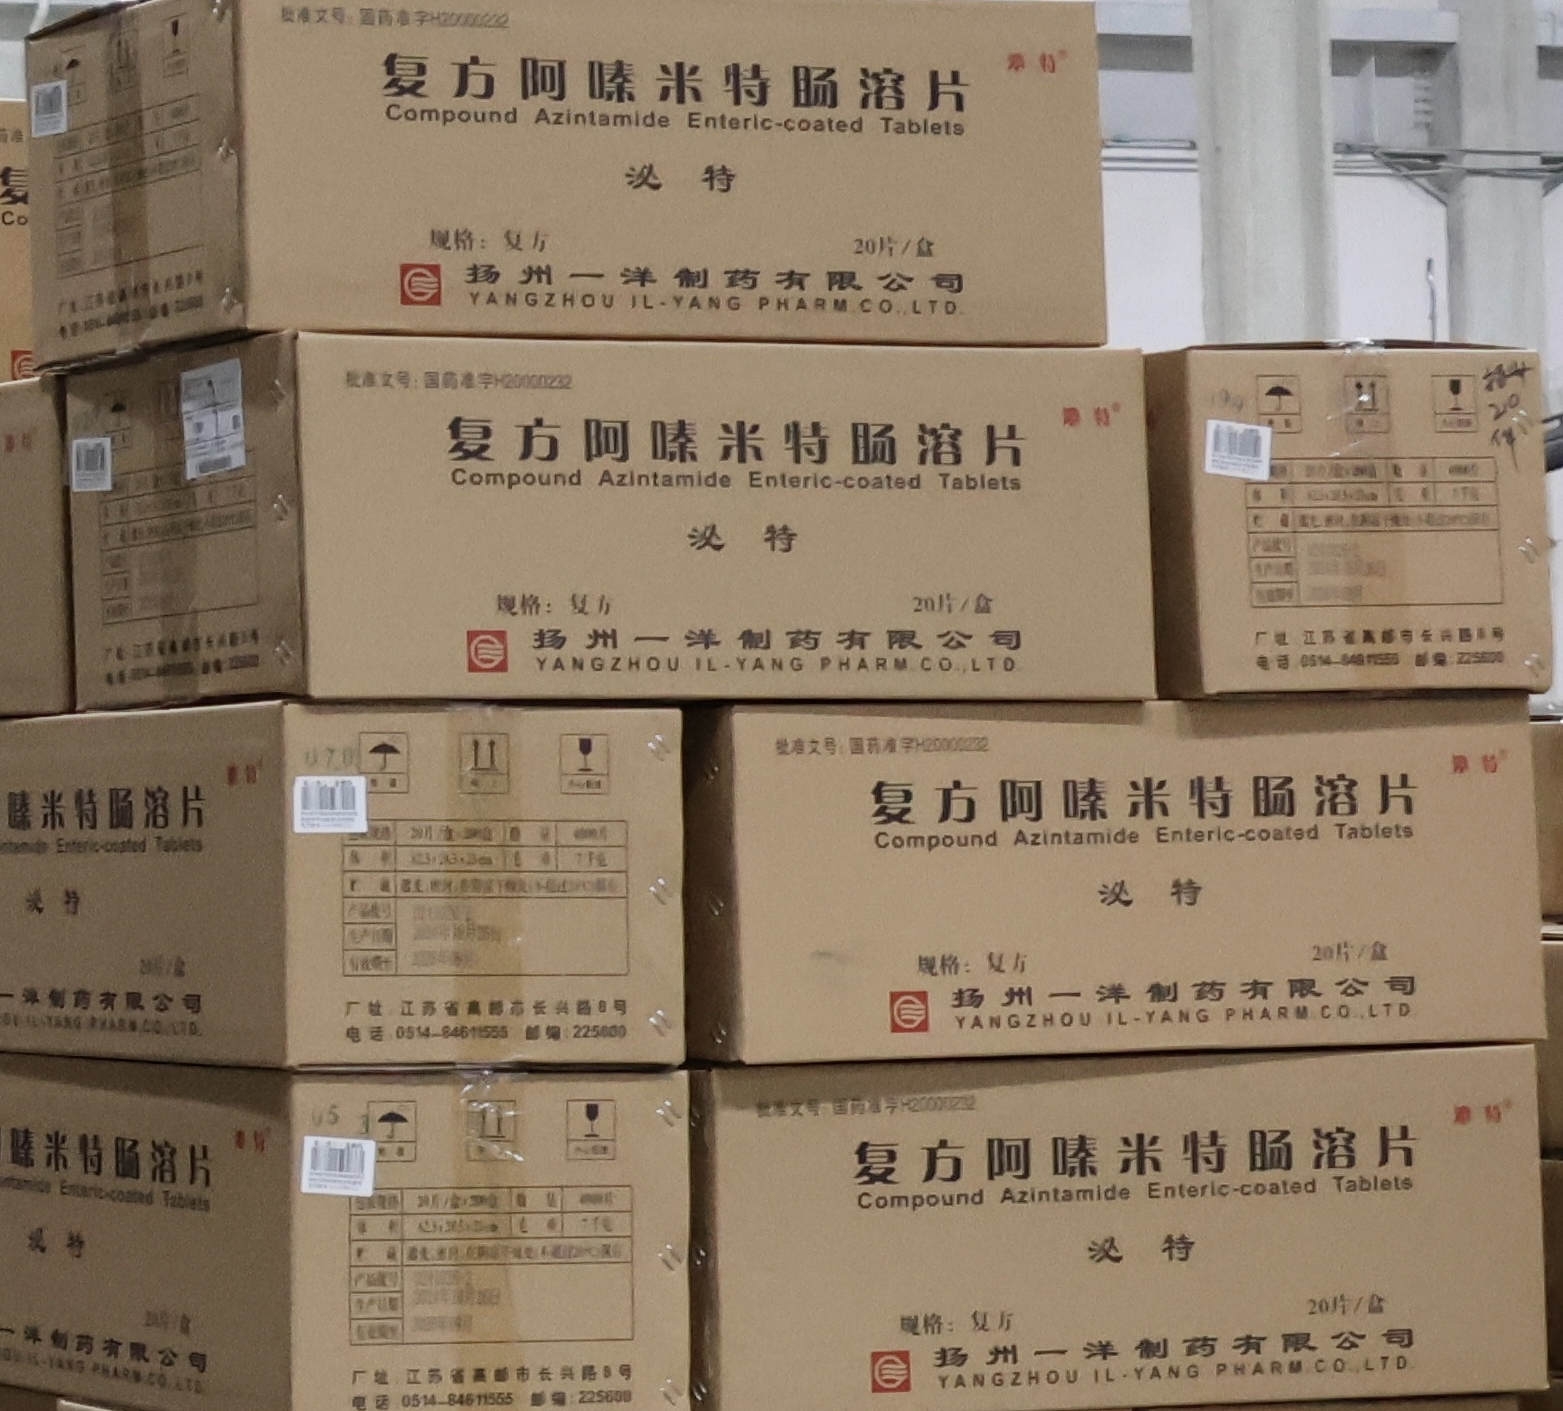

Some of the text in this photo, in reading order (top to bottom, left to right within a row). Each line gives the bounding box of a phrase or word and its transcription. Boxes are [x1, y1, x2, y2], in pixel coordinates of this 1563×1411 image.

[383, 52, 969, 112] 复方阿嗪米特肠溶片
[385, 104, 965, 136] Compound Azintamide Enteric-coated Tablets
[464, 264, 964, 293] 扬州一洋制药有限公司
[470, 293, 614, 309] YANGZHOU
[447, 416, 1026, 467] 复方阿嗪米特肠溶片
[452, 469, 1021, 491] Compound Azintamide Enteric-coated Tablets
[532, 628, 1022, 651] 扬州一洋制药有限公司
[536, 656, 679, 671] YANGZHOU
[871, 773, 1417, 825] 复方阿嗪米特肠溶片
[874, 823, 1414, 851] Compound Azintamide Enteric-coated Tablets
[951, 975, 1417, 1009] 扬州一洋制药有限公司
[955, 1012, 1091, 1030] YANGZHOU
[854, 1125, 1419, 1185] 复方阿嗪米特肠溶片
[858, 1176, 1413, 1210] Compound Azintamide Enteric-coated Tablets
[933, 1328, 1414, 1368] 扬州一洋制药有限公司
[939, 1369, 1078, 1389] YANGZHOU
